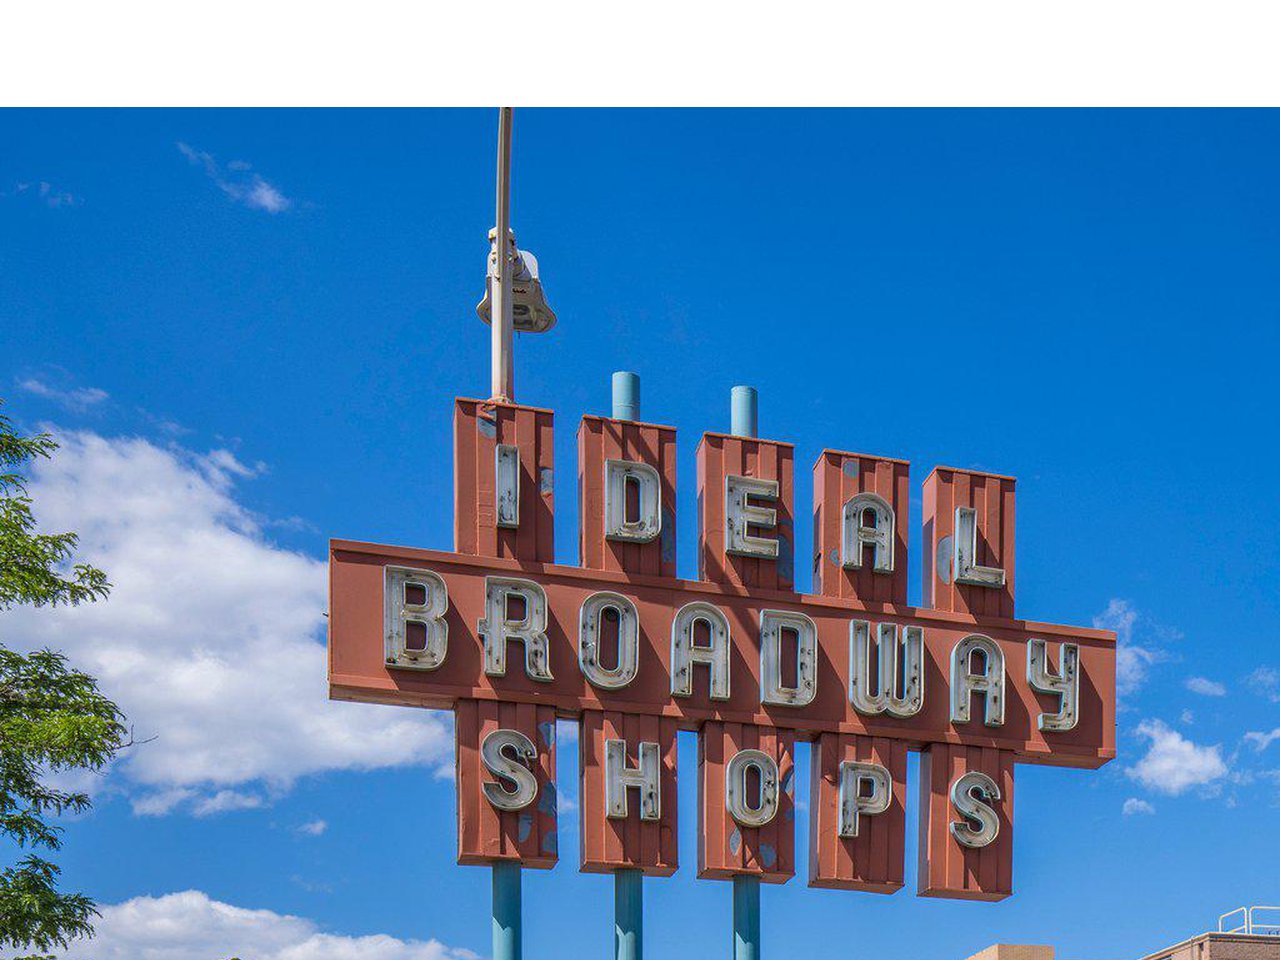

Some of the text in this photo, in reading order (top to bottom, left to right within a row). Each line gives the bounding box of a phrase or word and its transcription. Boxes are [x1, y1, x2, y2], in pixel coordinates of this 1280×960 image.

[495, 443, 1007, 588] IDEAL
[384, 564, 1080, 732] BROADWAY
[480, 729, 1002, 848] SHOPS
